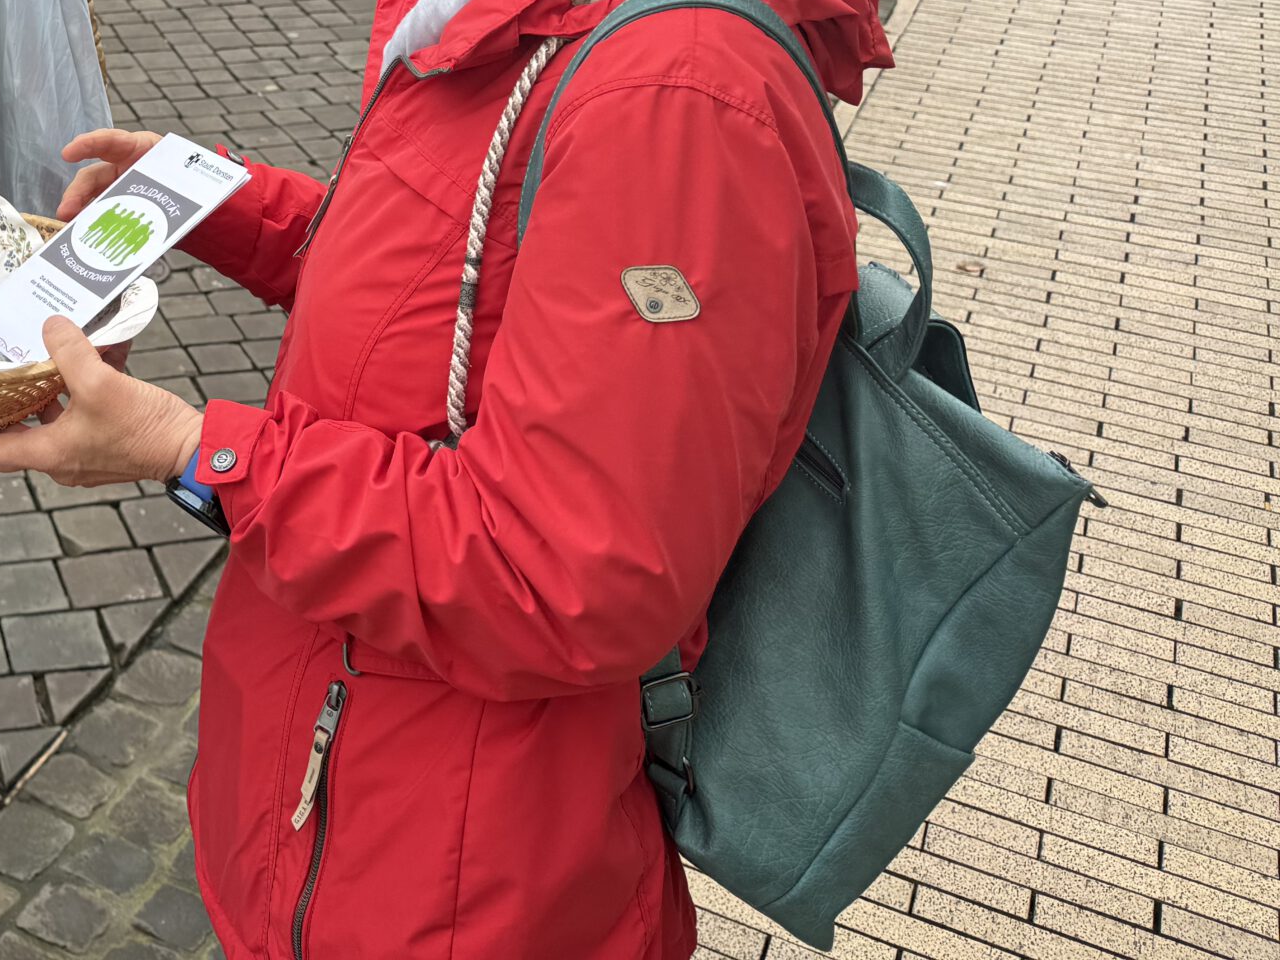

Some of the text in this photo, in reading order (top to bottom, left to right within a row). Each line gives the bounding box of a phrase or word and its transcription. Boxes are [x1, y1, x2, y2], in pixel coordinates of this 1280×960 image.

[127, 183, 181, 218] SOLIDARITÄT
[59, 243, 116, 283] DER GENERATIONEN
